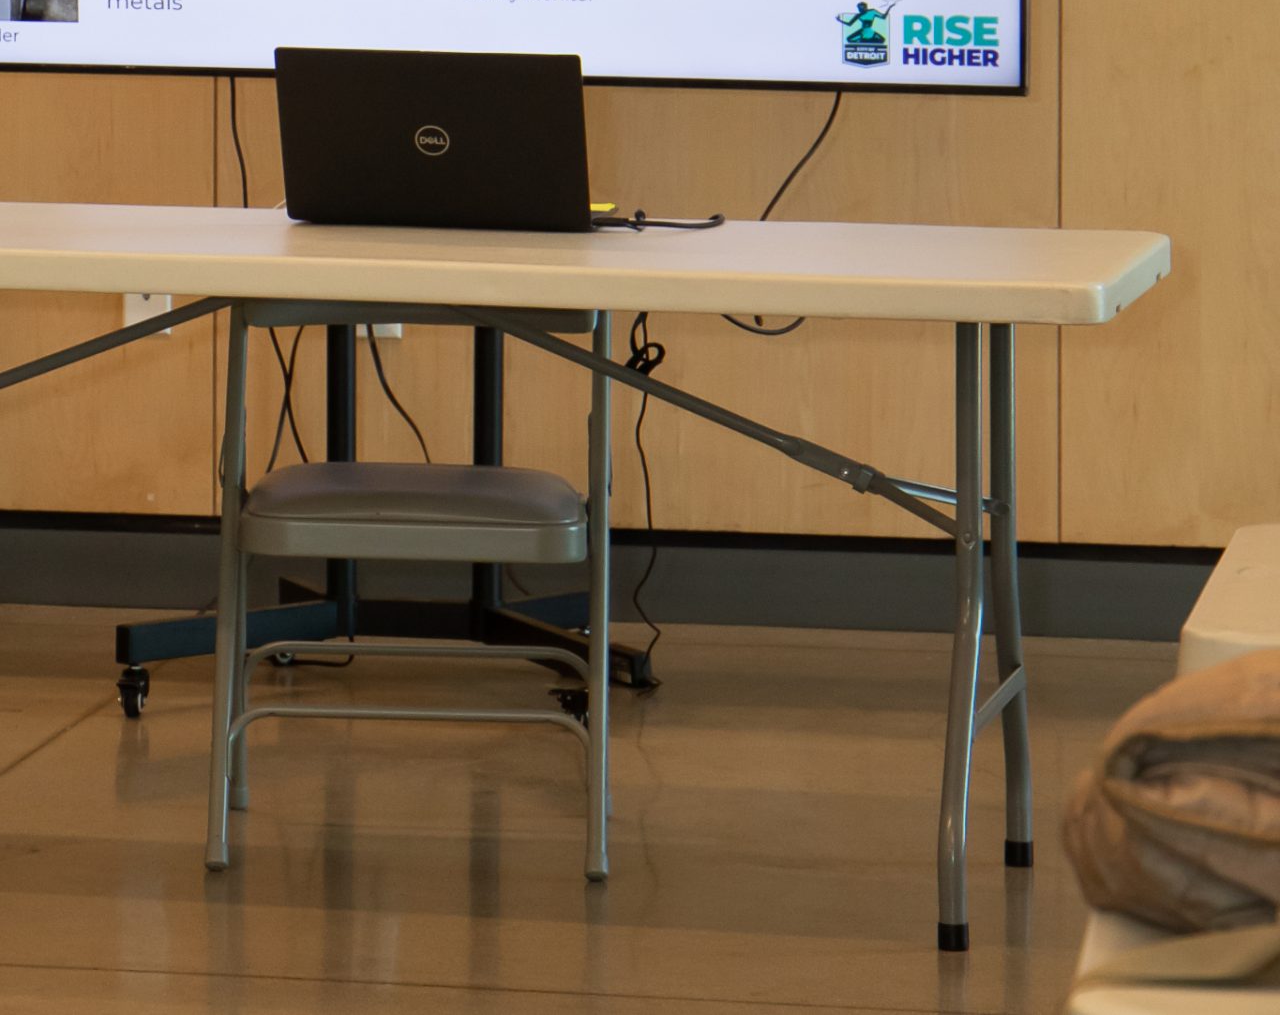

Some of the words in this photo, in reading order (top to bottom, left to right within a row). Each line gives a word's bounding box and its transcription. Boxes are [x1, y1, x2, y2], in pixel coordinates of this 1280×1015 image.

[903, 14, 999, 46] RISE
[846, 51, 886, 60] DETROIT
[902, 47, 999, 67] HIGHER
[419, 136, 446, 145] DELL
